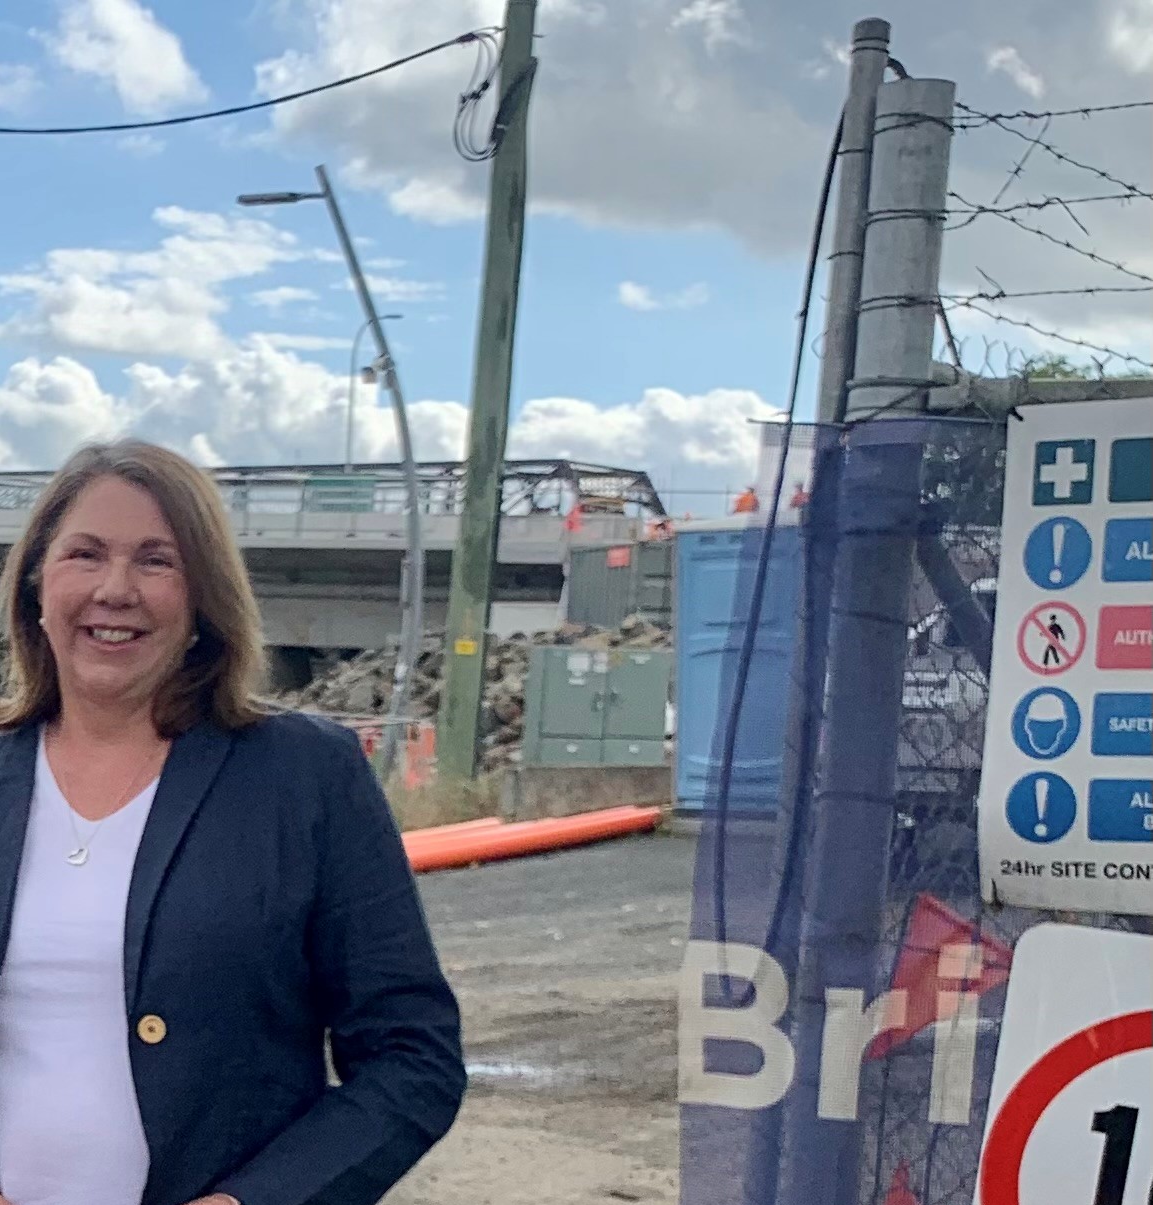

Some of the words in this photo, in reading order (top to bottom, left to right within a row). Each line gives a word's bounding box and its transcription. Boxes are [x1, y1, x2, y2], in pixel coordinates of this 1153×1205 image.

[1000, 859, 1045, 877] 24hr
[1051, 861, 1096, 879] SITE
[677, 939, 983, 1126] Bri
